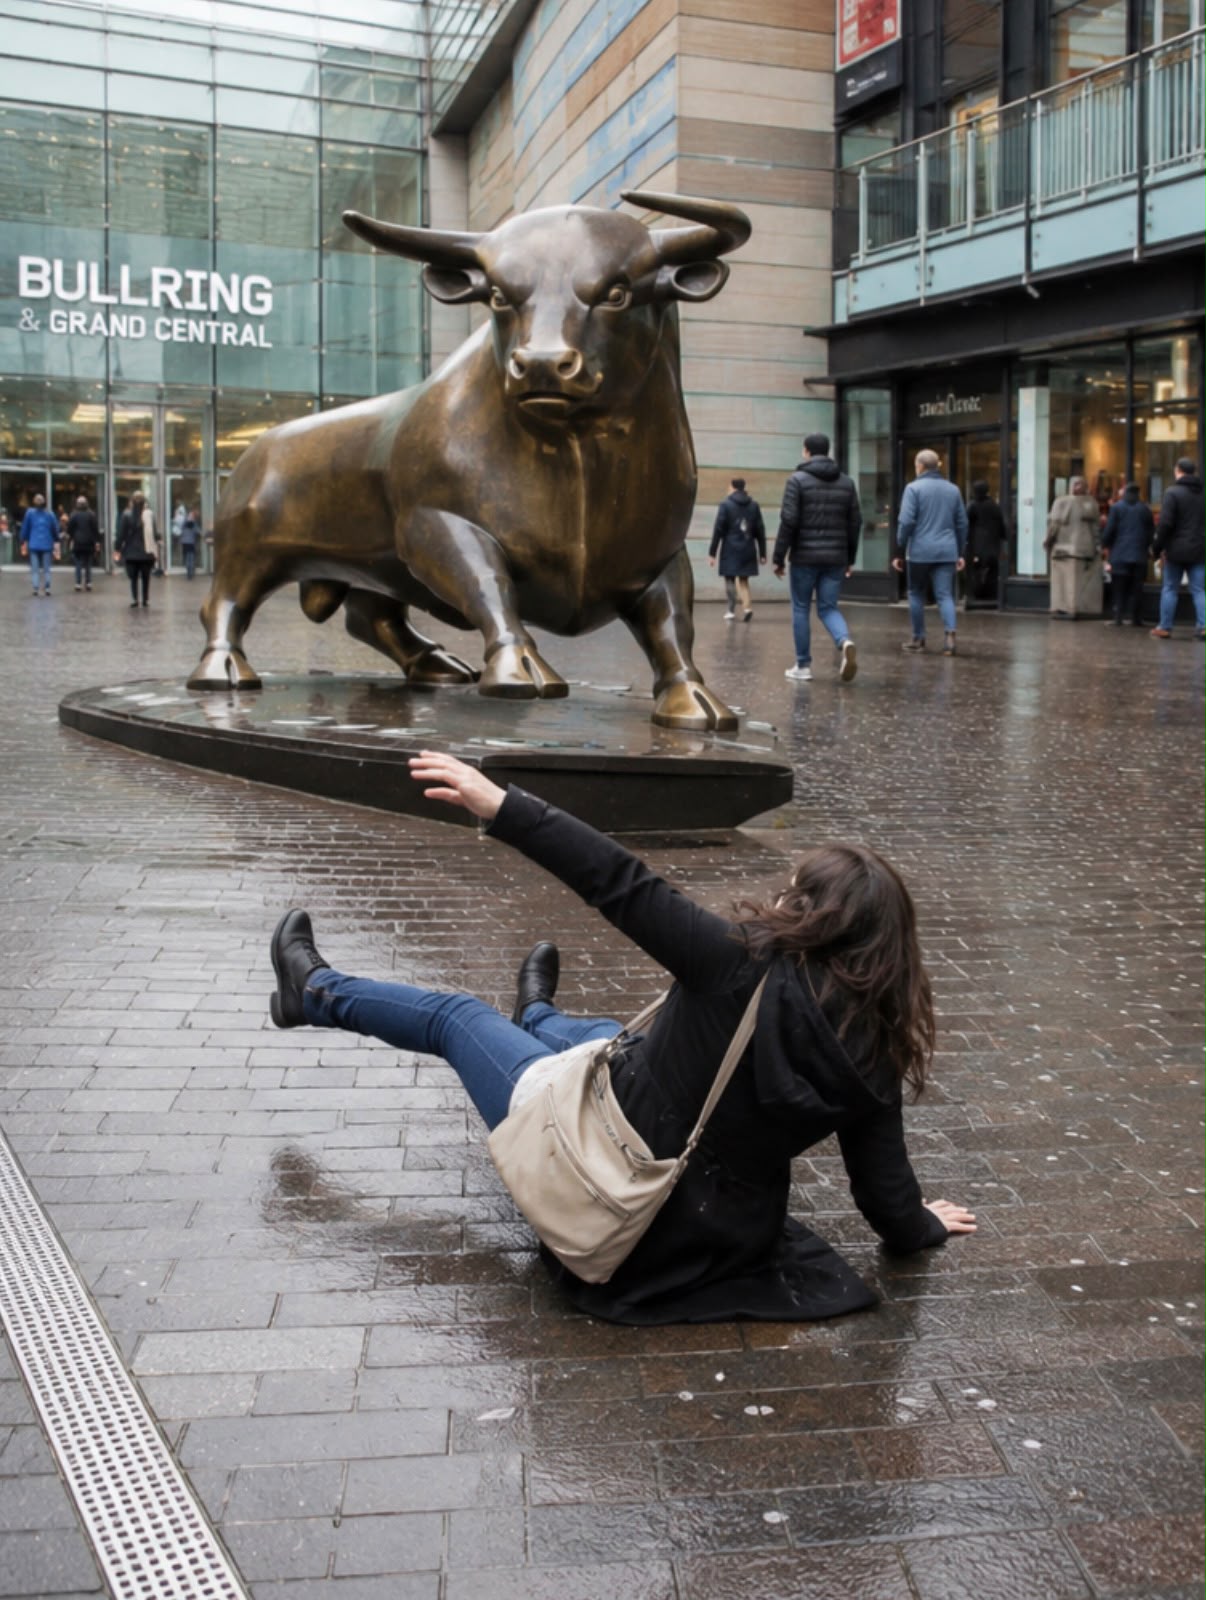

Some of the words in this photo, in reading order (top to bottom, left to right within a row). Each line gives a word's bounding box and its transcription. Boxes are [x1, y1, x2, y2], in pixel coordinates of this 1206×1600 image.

[19, 255, 273, 316] BULLRING
[19, 308, 40, 332] &
[50, 309, 146, 339] GRAND
[155, 317, 273, 348] CENTRAL
